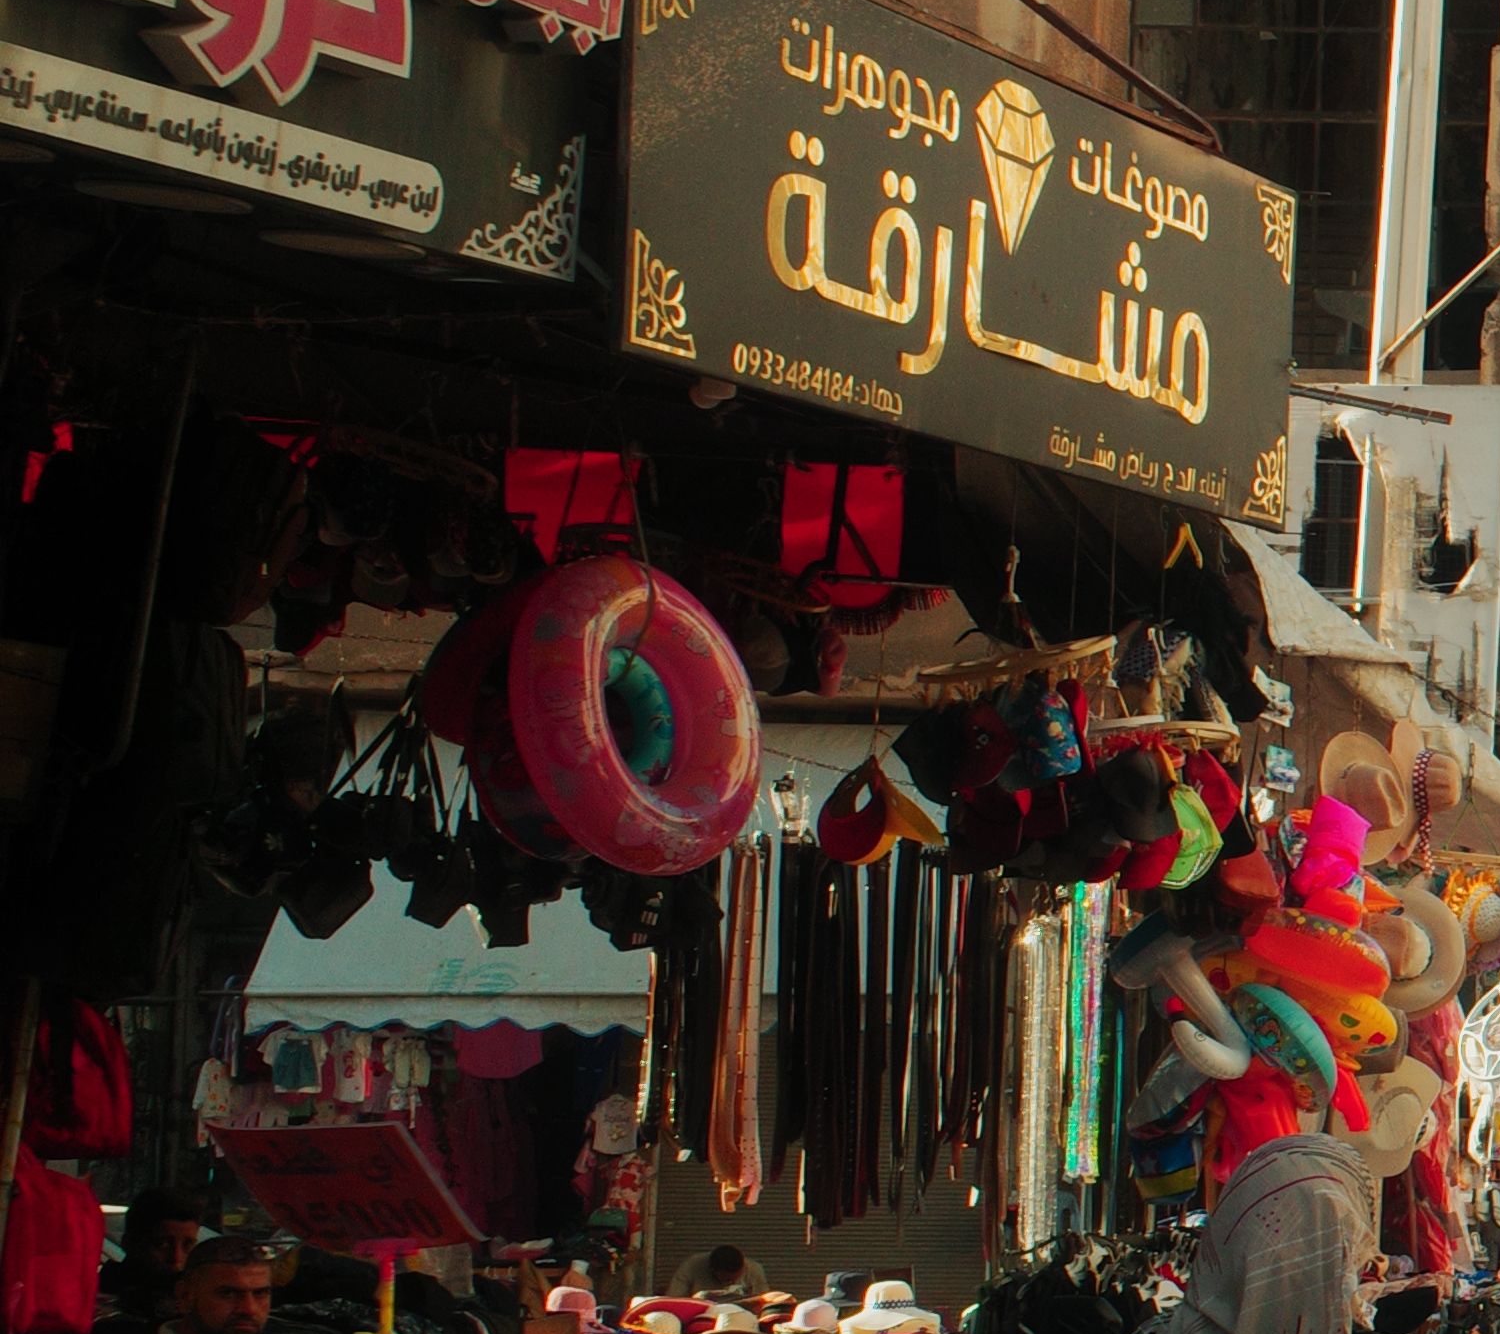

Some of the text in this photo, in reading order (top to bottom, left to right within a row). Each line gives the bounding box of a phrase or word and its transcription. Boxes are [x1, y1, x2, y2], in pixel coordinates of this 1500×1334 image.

[780, 18, 1209, 241] مصوغات مجوهرات
[227, 132, 278, 176] زيتون
[332, 164, 361, 196] لبن
[410, 184, 439, 218] لبن
[1119, 447, 1159, 488] رياض
[1200, 467, 1229, 506] أبناء
